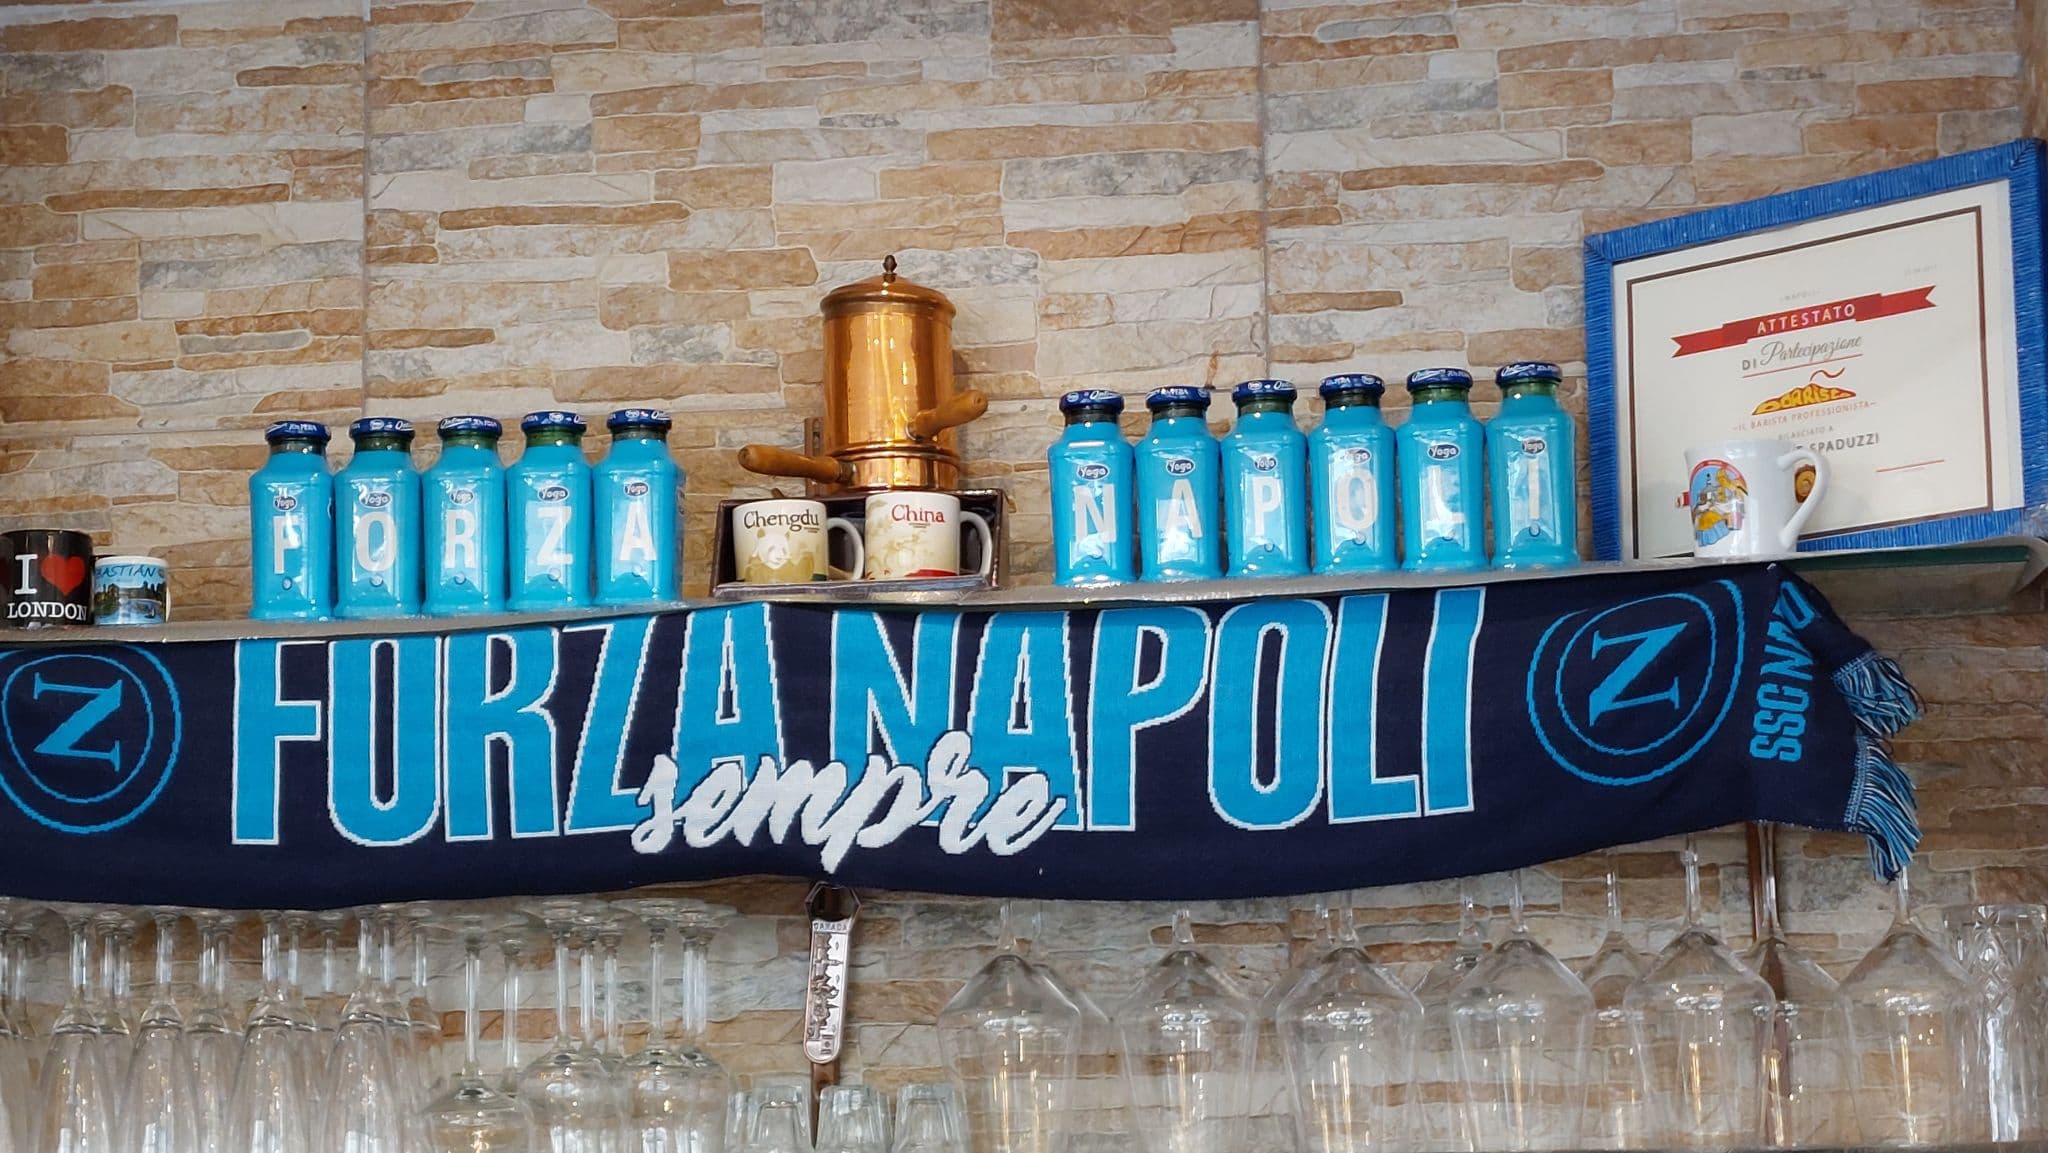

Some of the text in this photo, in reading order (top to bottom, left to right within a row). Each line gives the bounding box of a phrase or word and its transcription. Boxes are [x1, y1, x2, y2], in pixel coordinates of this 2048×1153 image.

[1757, 304, 1856, 334] ATTESTATO
[1742, 336, 1862, 371] DI Partecipazione
[1750, 416, 1788, 431] BARISTA
[1429, 445, 1460, 459] Yoga
[1078, 463, 1107, 480] Yoga
[1168, 457, 1194, 474] Yoga
[540, 486, 566, 501] Yoga
[743, 509, 819, 533] Chengdu
[891, 503, 945, 524] China
[14, 553, 38, 595] I
[6, 601, 87, 621] LONDON
[231, 585, 1487, 847] FORZA NAPOLI
[630, 730, 1068, 875] sempre
